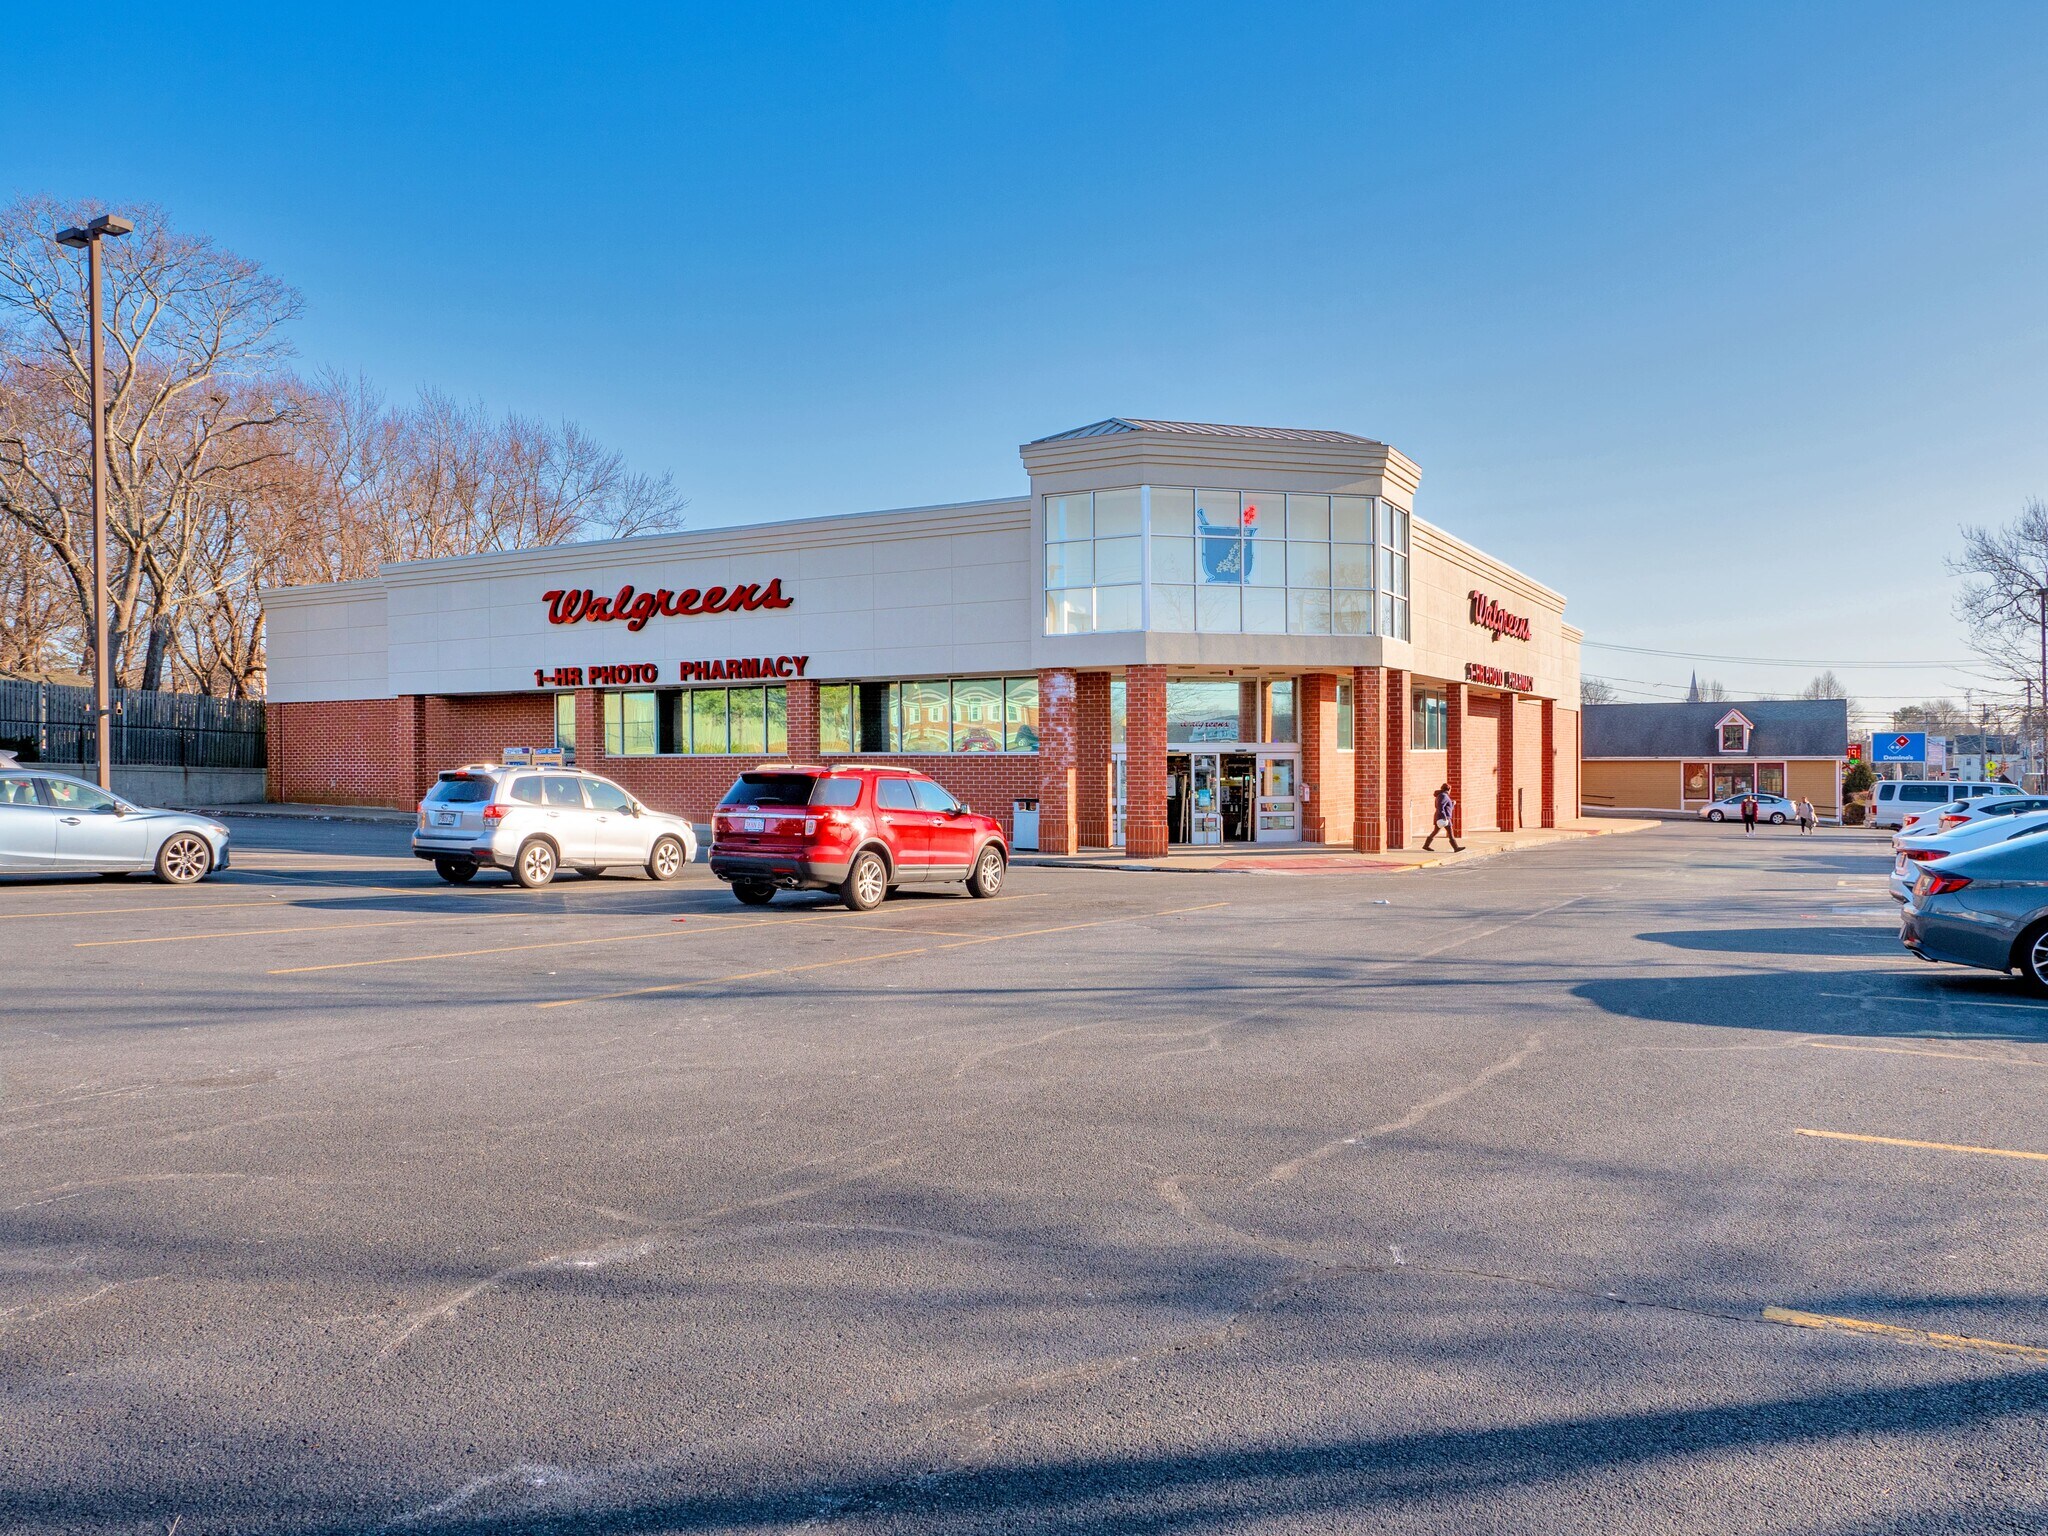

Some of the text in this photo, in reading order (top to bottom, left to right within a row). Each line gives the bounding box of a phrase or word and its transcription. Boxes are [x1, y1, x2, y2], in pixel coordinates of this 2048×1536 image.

[542, 578, 794, 632] Walgreens
[1467, 590, 1532, 642] Walgreens
[534, 656, 810, 687] 1-HR PHOTO PHARMACY
